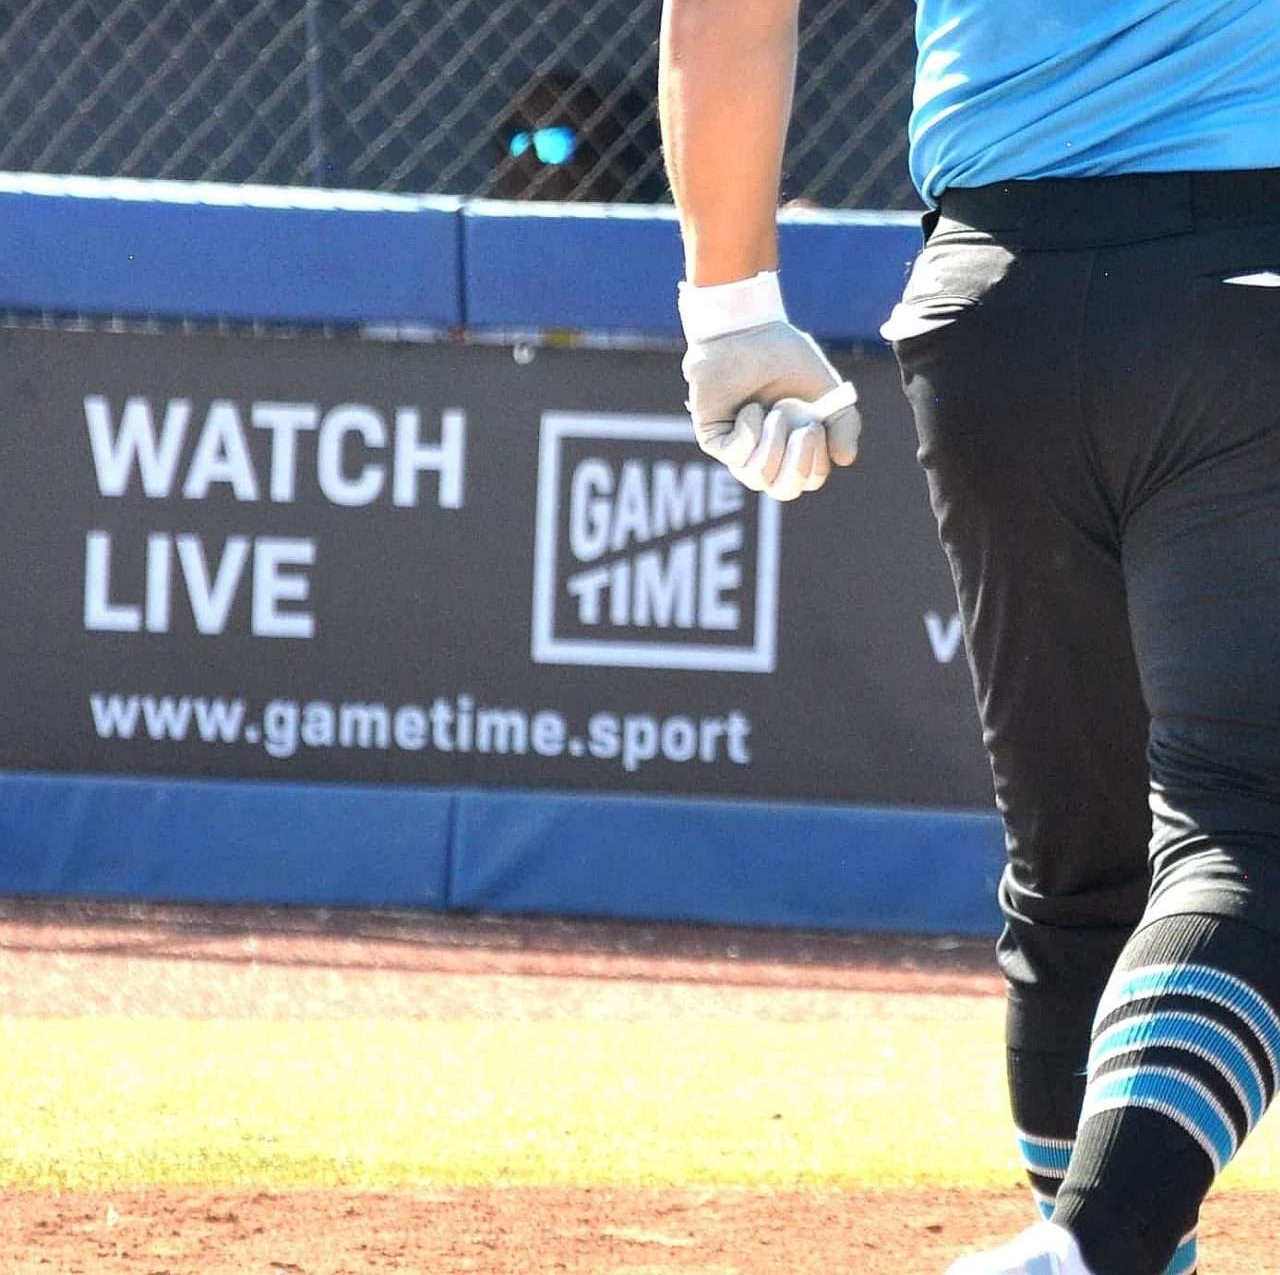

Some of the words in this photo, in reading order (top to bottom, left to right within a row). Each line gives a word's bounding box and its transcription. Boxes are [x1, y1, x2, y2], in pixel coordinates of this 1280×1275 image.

[83, 394, 466, 509] WATCH
[569, 456, 744, 563] GAME
[83, 529, 318, 639] LIVE
[565, 522, 744, 631] TIME
[88, 692, 752, 772] www.gametime.sport
